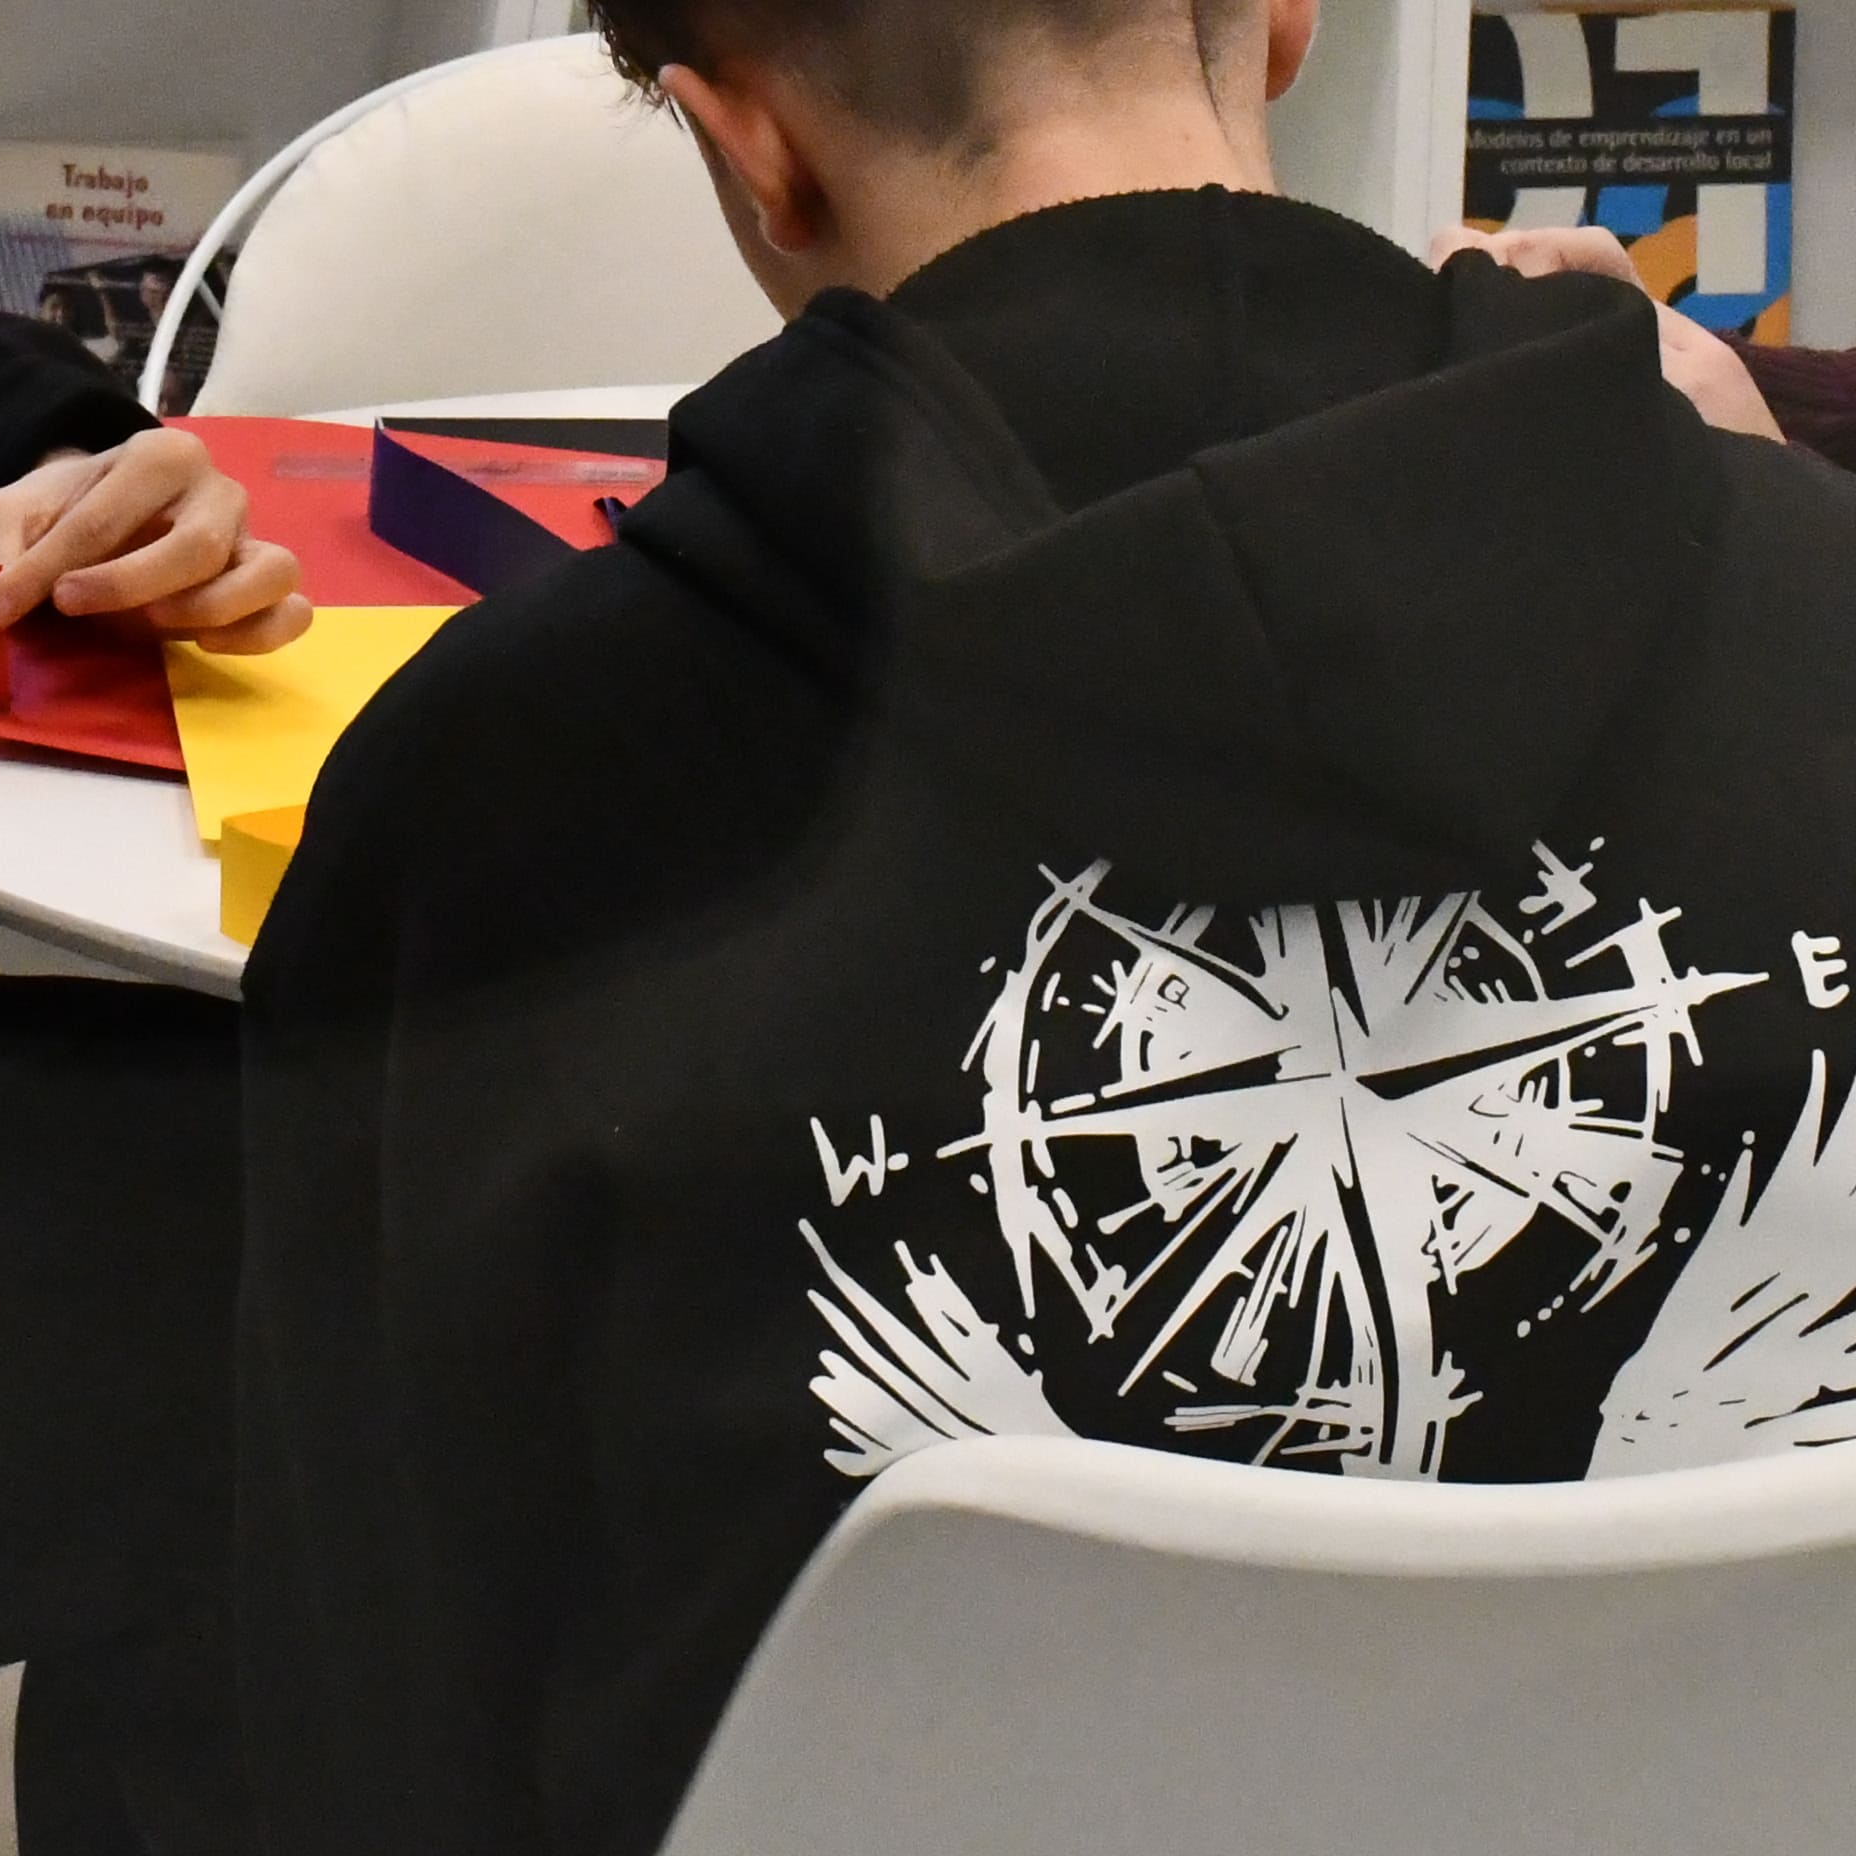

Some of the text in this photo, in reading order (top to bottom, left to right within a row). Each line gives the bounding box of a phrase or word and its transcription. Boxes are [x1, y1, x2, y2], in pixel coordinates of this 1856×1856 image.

[1726, 149, 1773, 170] local
[62, 162, 149, 199] Trabajo
[82, 202, 164, 230] equipo
